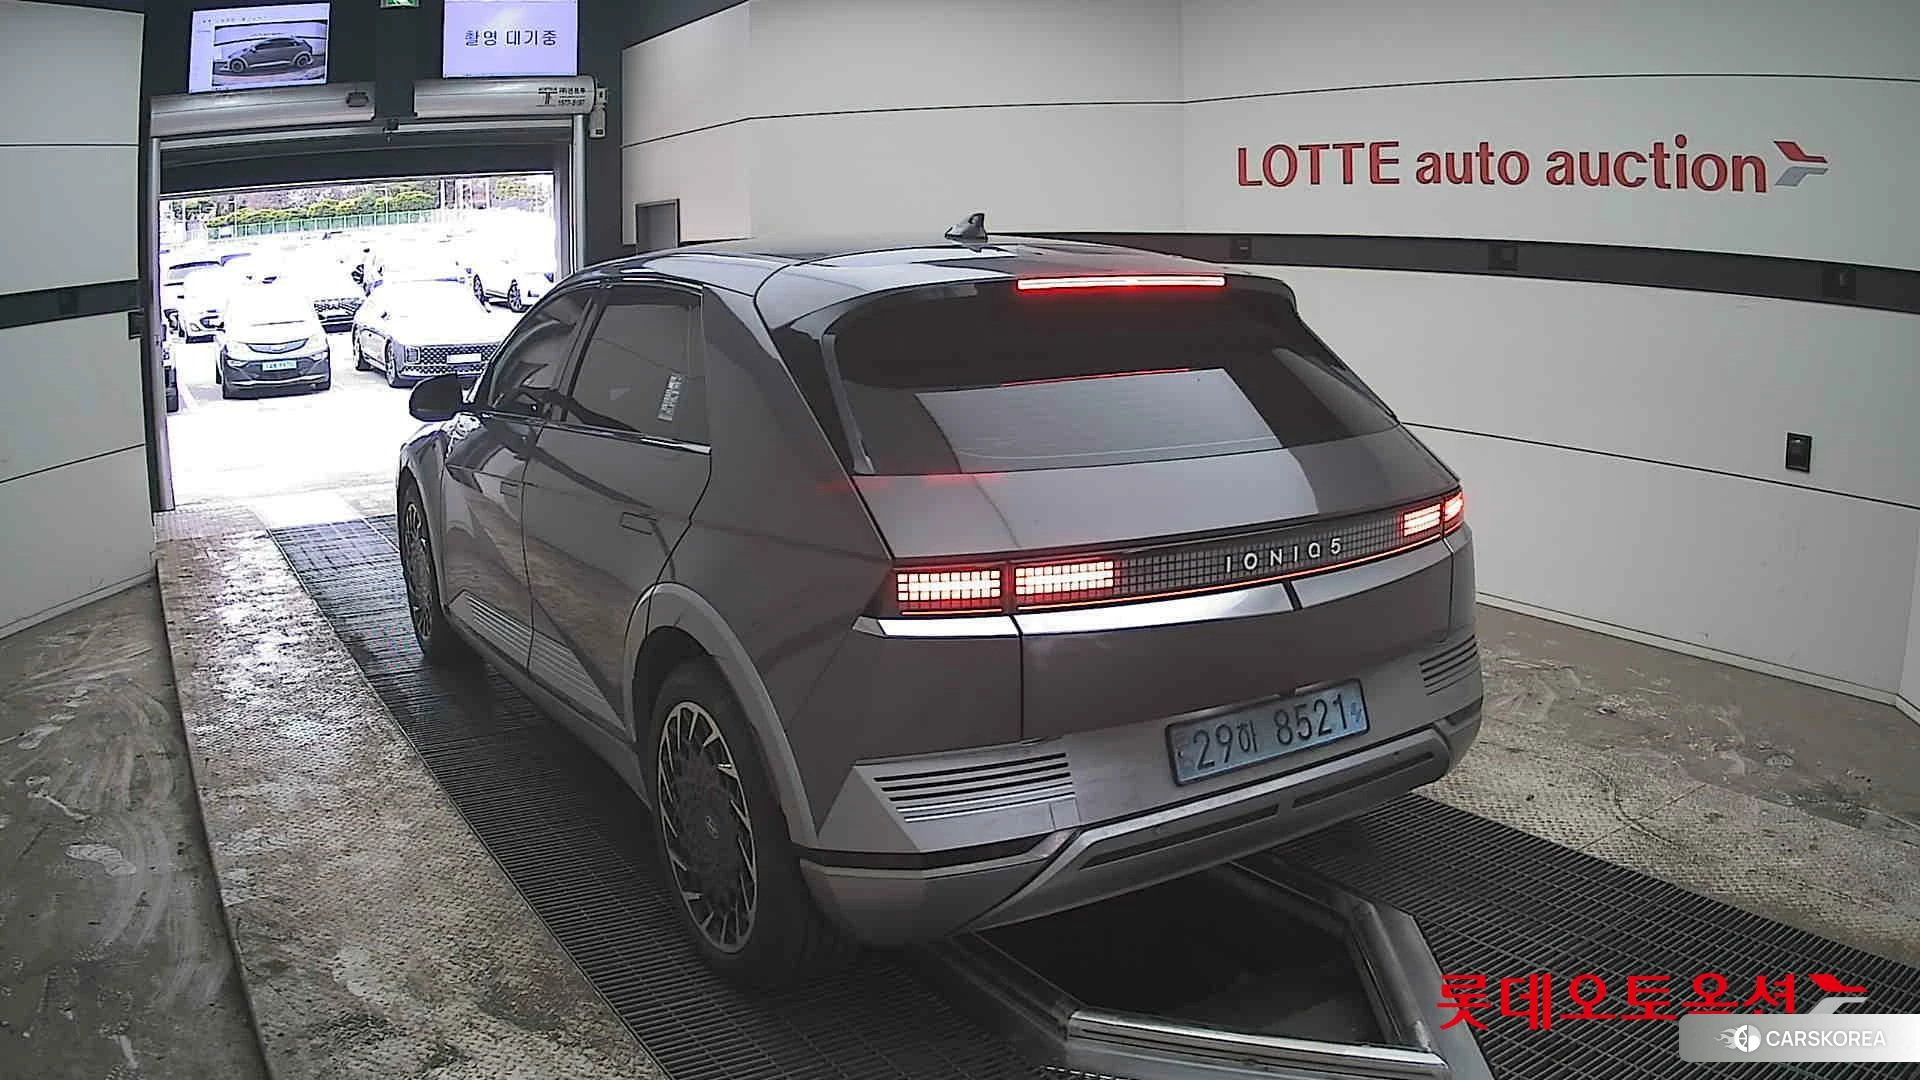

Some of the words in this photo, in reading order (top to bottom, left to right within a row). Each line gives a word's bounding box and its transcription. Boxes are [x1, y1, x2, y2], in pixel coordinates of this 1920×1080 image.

[465, 30, 497, 46] 촬영
[506, 30, 557, 46] 대기중
[1238, 141, 1400, 187] LOTTE
[1415, 142, 1530, 185] auto
[1546, 134, 1767, 193] auction
[1274, 694, 1348, 745] 8521
